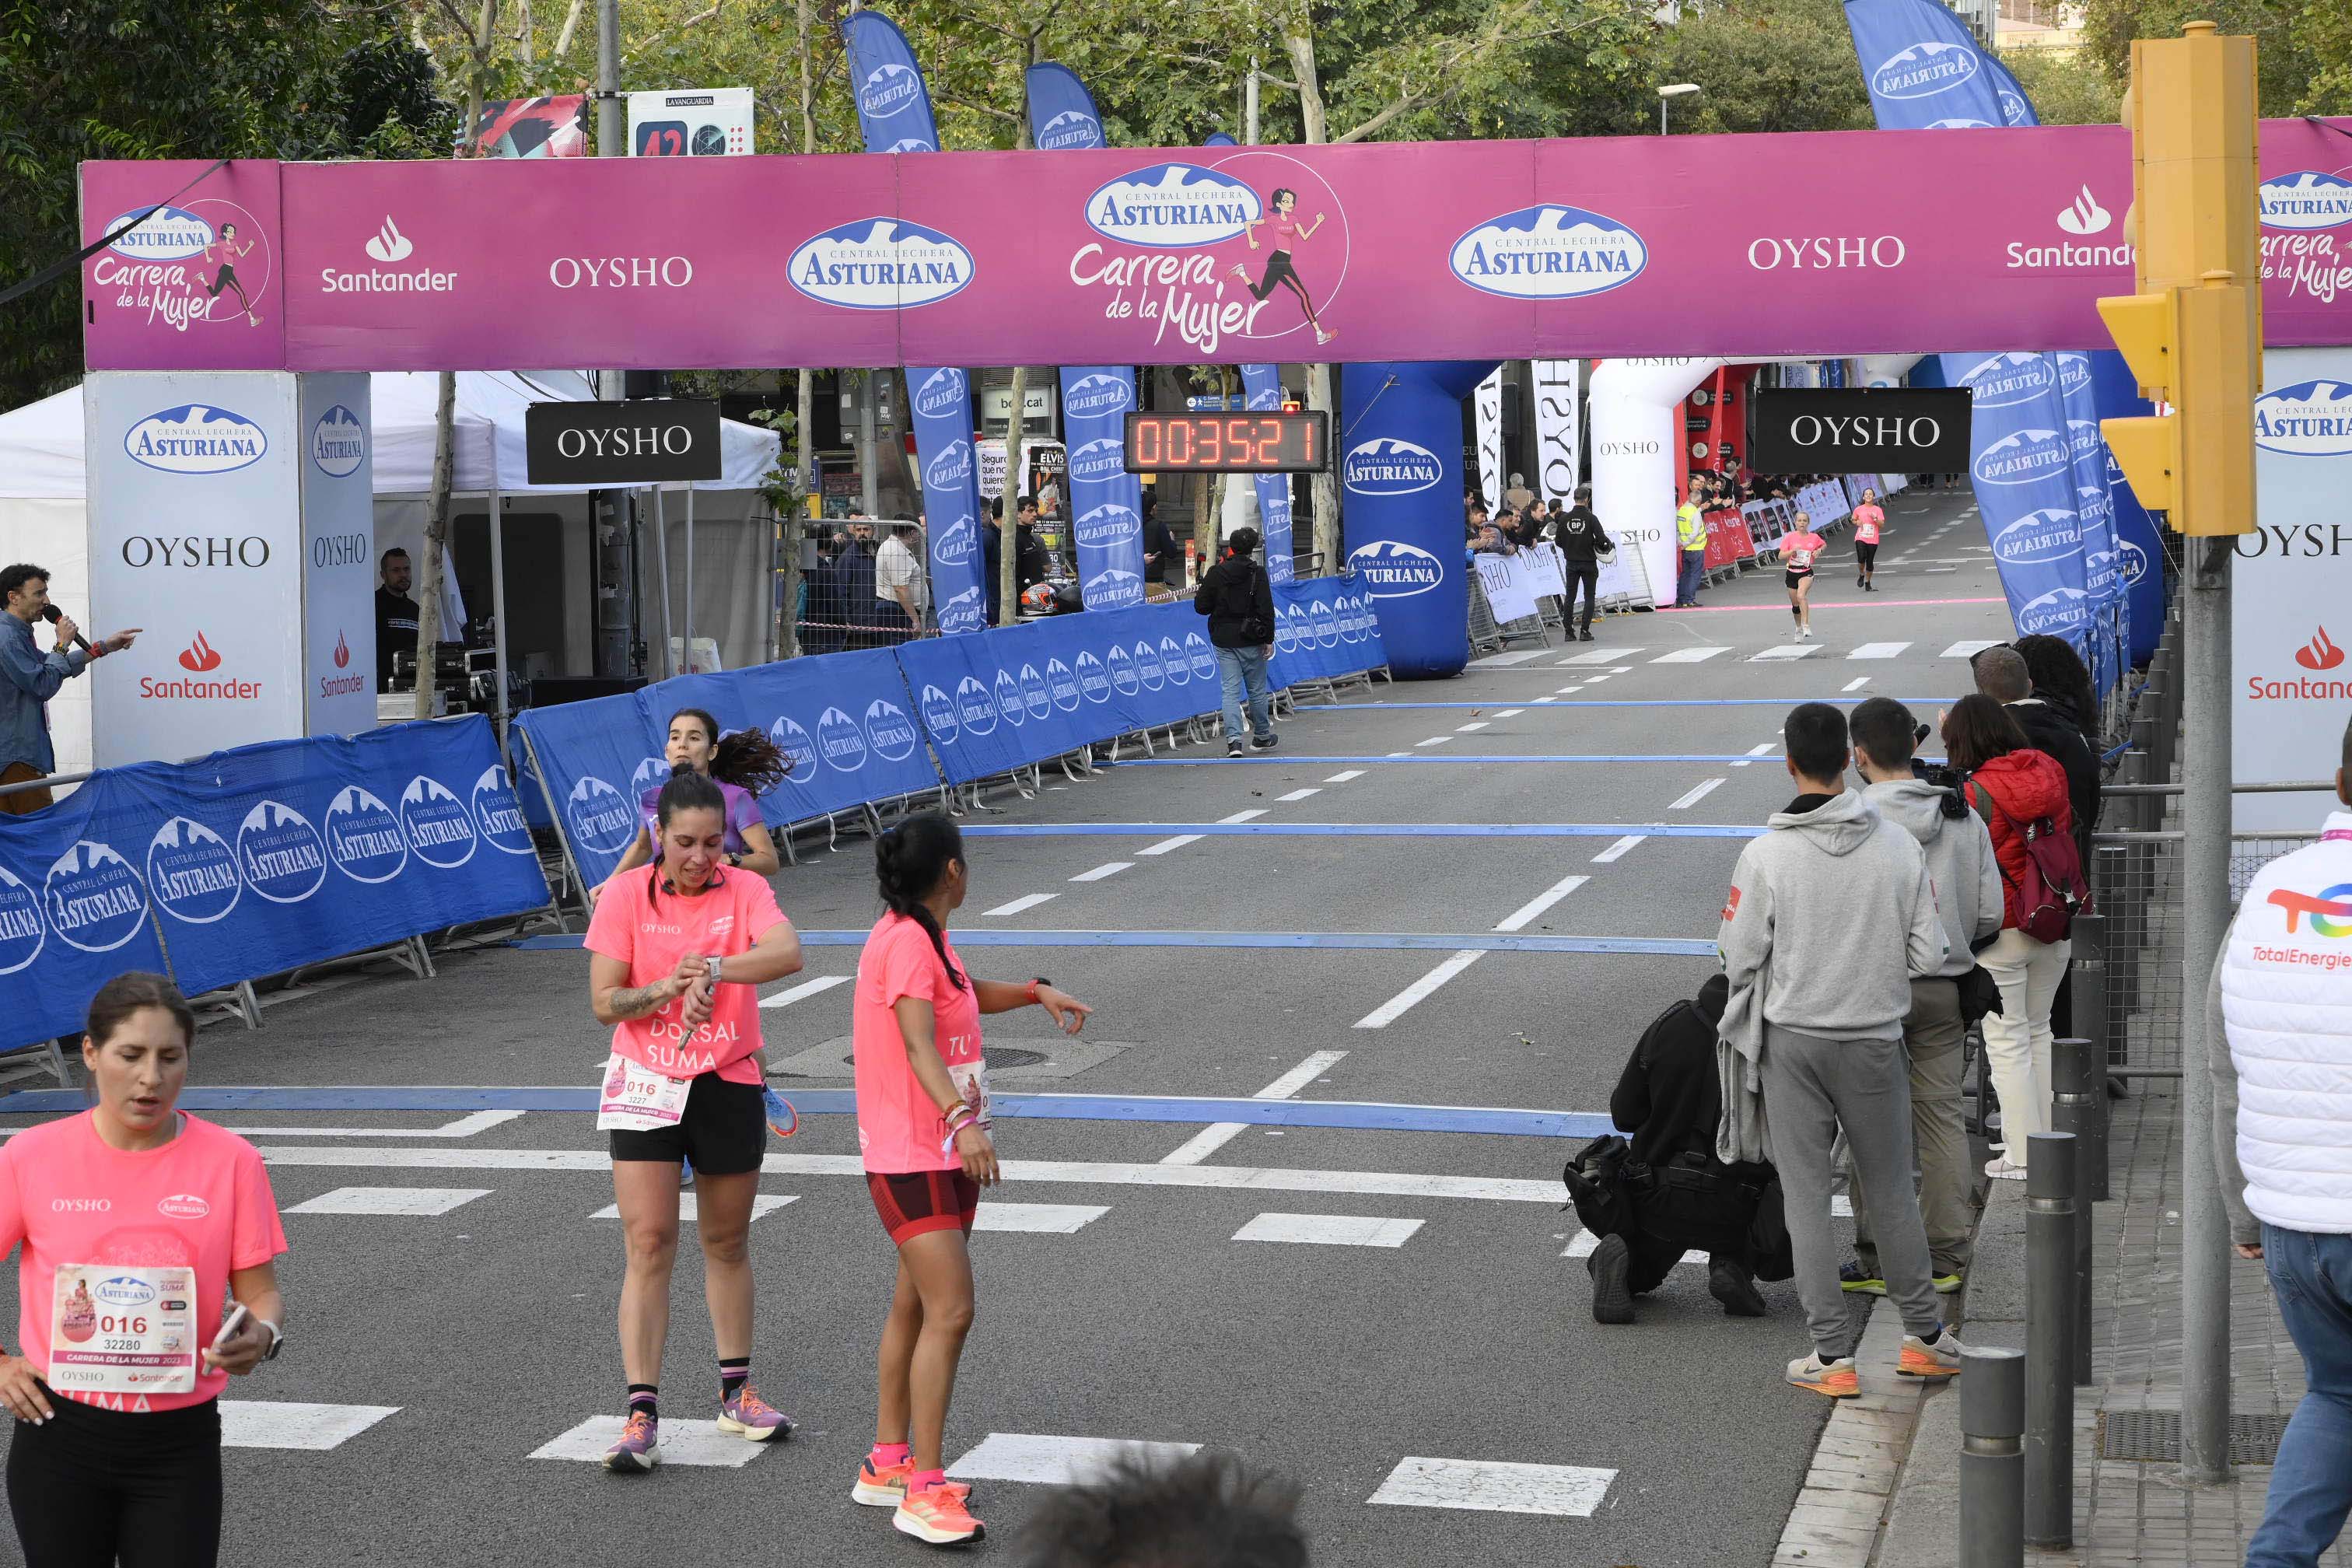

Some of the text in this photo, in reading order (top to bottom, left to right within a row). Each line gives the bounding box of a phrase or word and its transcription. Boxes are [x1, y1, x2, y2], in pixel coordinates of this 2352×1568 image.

[1125, 191, 1243, 201] CENTRAL LECHERA
[1099, 195, 1248, 226] ASTURIANA
[830, 250, 888, 259] CENTRAL
[1495, 236, 1626, 247] CENTRAL LECHERA
[1748, 235, 1906, 270] OYSHO
[2007, 241, 2137, 268] Santand
[2259, 234, 2334, 257] arrera
[801, 252, 960, 285] ASTURIANA
[1070, 243, 1216, 286] Carrera
[1465, 240, 1632, 275] ASTURIANA
[2278, 257, 2292, 278] la
[94, 257, 186, 286] Carrera
[322, 268, 457, 292] Santander
[550, 257, 693, 288] OYSHO
[117, 283, 220, 331] de la Mujer
[1106, 281, 1269, 354] de la Mujer
[136, 430, 257, 457] ASTURIANA
[558, 425, 692, 457] OYSHO
[1138, 421, 1312, 464] 00:35:21
[1790, 415, 1940, 447] OYSHO
[317, 436, 362, 460] ASTURIANA
[1040, 453, 1064, 464] ELVIS
[1600, 440, 1659, 457] OYSHO
[1347, 461, 1435, 483] ASTURIANA
[122, 536, 270, 568] OYSHO
[314, 533, 366, 569] OYSHO
[140, 677, 262, 699] Santander
[321, 672, 365, 698] Santander
[332, 824, 404, 863] ASTURIANA
[408, 813, 474, 849] ASTURIANA
[246, 843, 323, 883] ASTURIANA
[156, 861, 238, 902] ASTURIANA
[647, 1045, 717, 1070] SUMA
[627, 1081, 656, 1095] 016
[52, 1199, 111, 1213] OYSHO
[163, 1200, 205, 1214] ASTURIANA
[100, 1286, 151, 1300] ASTURIANA
[100, 1315, 148, 1334] 016
[103, 1339, 141, 1351] 32280
[66, 1353, 105, 1362] CARRERA
[131, 1356, 160, 1364] MUJER
[61, 1370, 104, 1382] OYSHO
